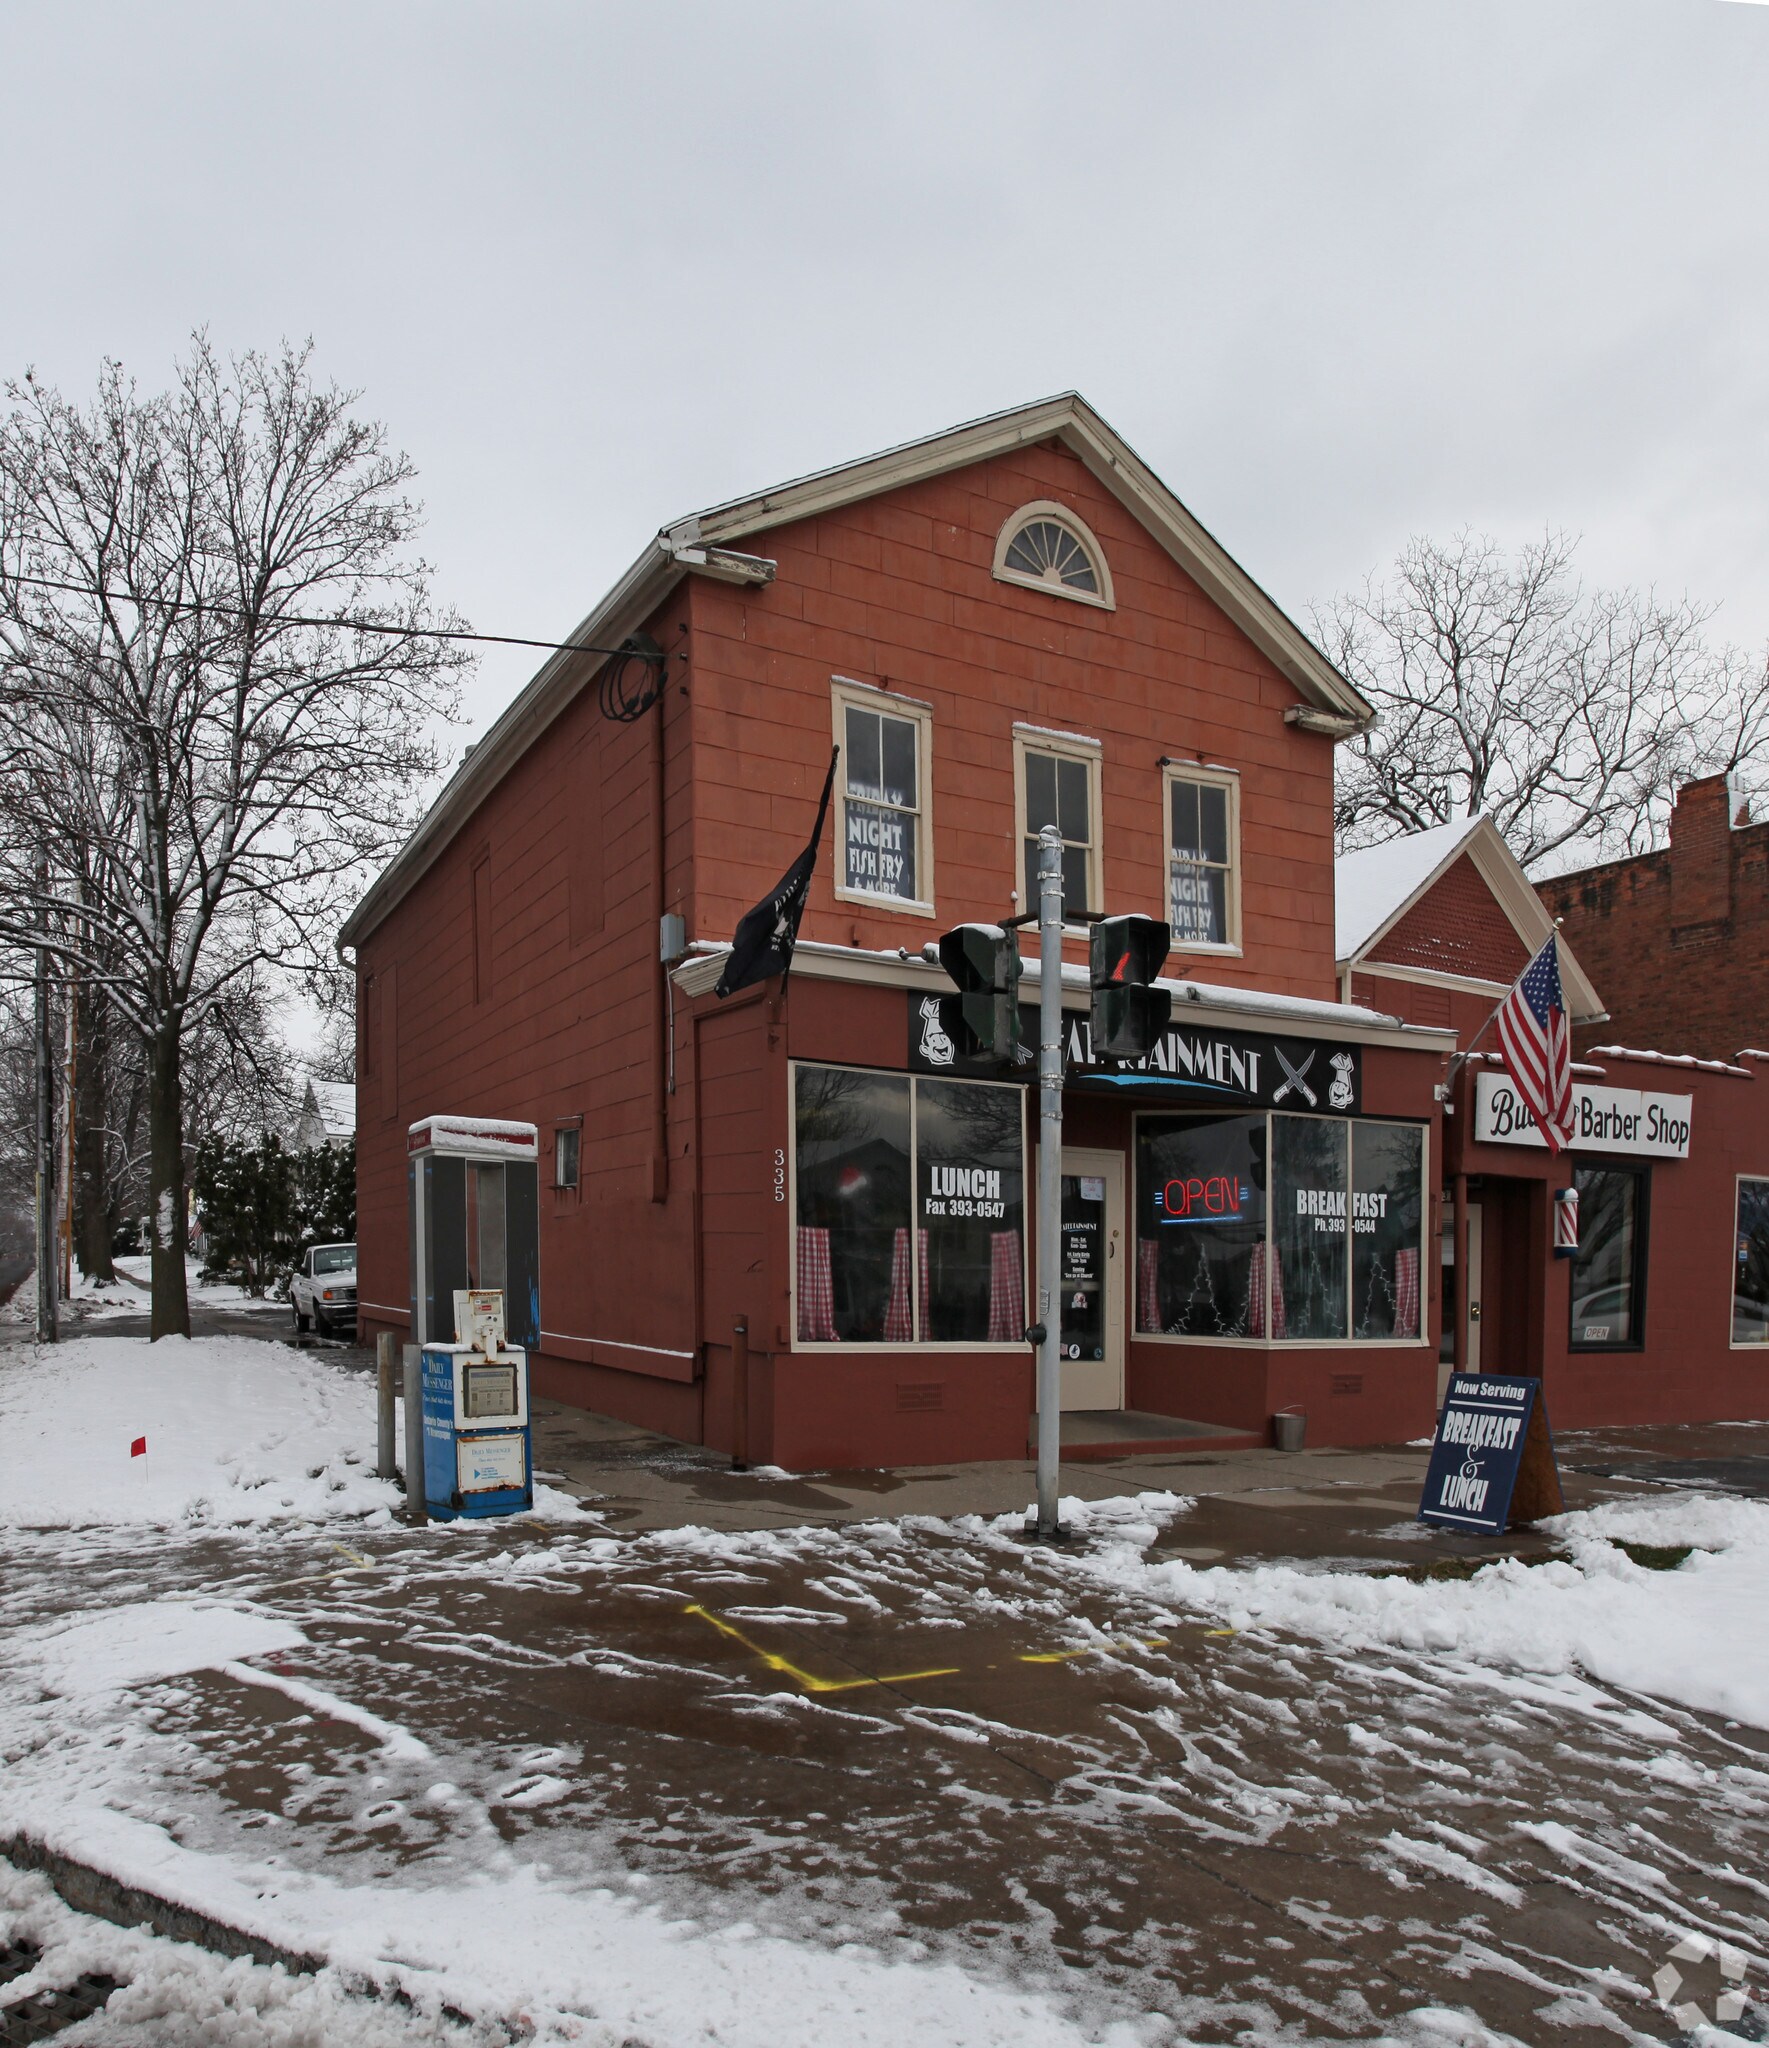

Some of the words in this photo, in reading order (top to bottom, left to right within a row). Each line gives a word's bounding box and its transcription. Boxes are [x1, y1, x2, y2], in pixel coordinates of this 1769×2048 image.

[848, 815, 902, 851] NIGHT
[848, 847, 878, 877] FISH
[880, 853, 904, 883] FRY
[854, 877, 863, 889] &
[1581, 1096, 1642, 1142] Barber
[1646, 1103, 1690, 1153] Shop
[931, 1166, 1000, 1199] LUNCH
[1164, 1176, 1240, 1215] OPEN
[925, 1198, 946, 1216] Fax
[949, 1199, 1005, 1218] 393-0547
[1586, 1327, 1608, 1338] OPEN
[422, 1373, 453, 1391] MESSENGER
[428, 1359, 445, 1375] DAILY
[1454, 1380, 1479, 1396] Now
[1479, 1382, 1527, 1401] Serving
[1441, 1410, 1523, 1450] BREAKFAST
[1459, 1443, 1486, 1483] &
[1439, 1474, 1490, 1512] LUNCH
